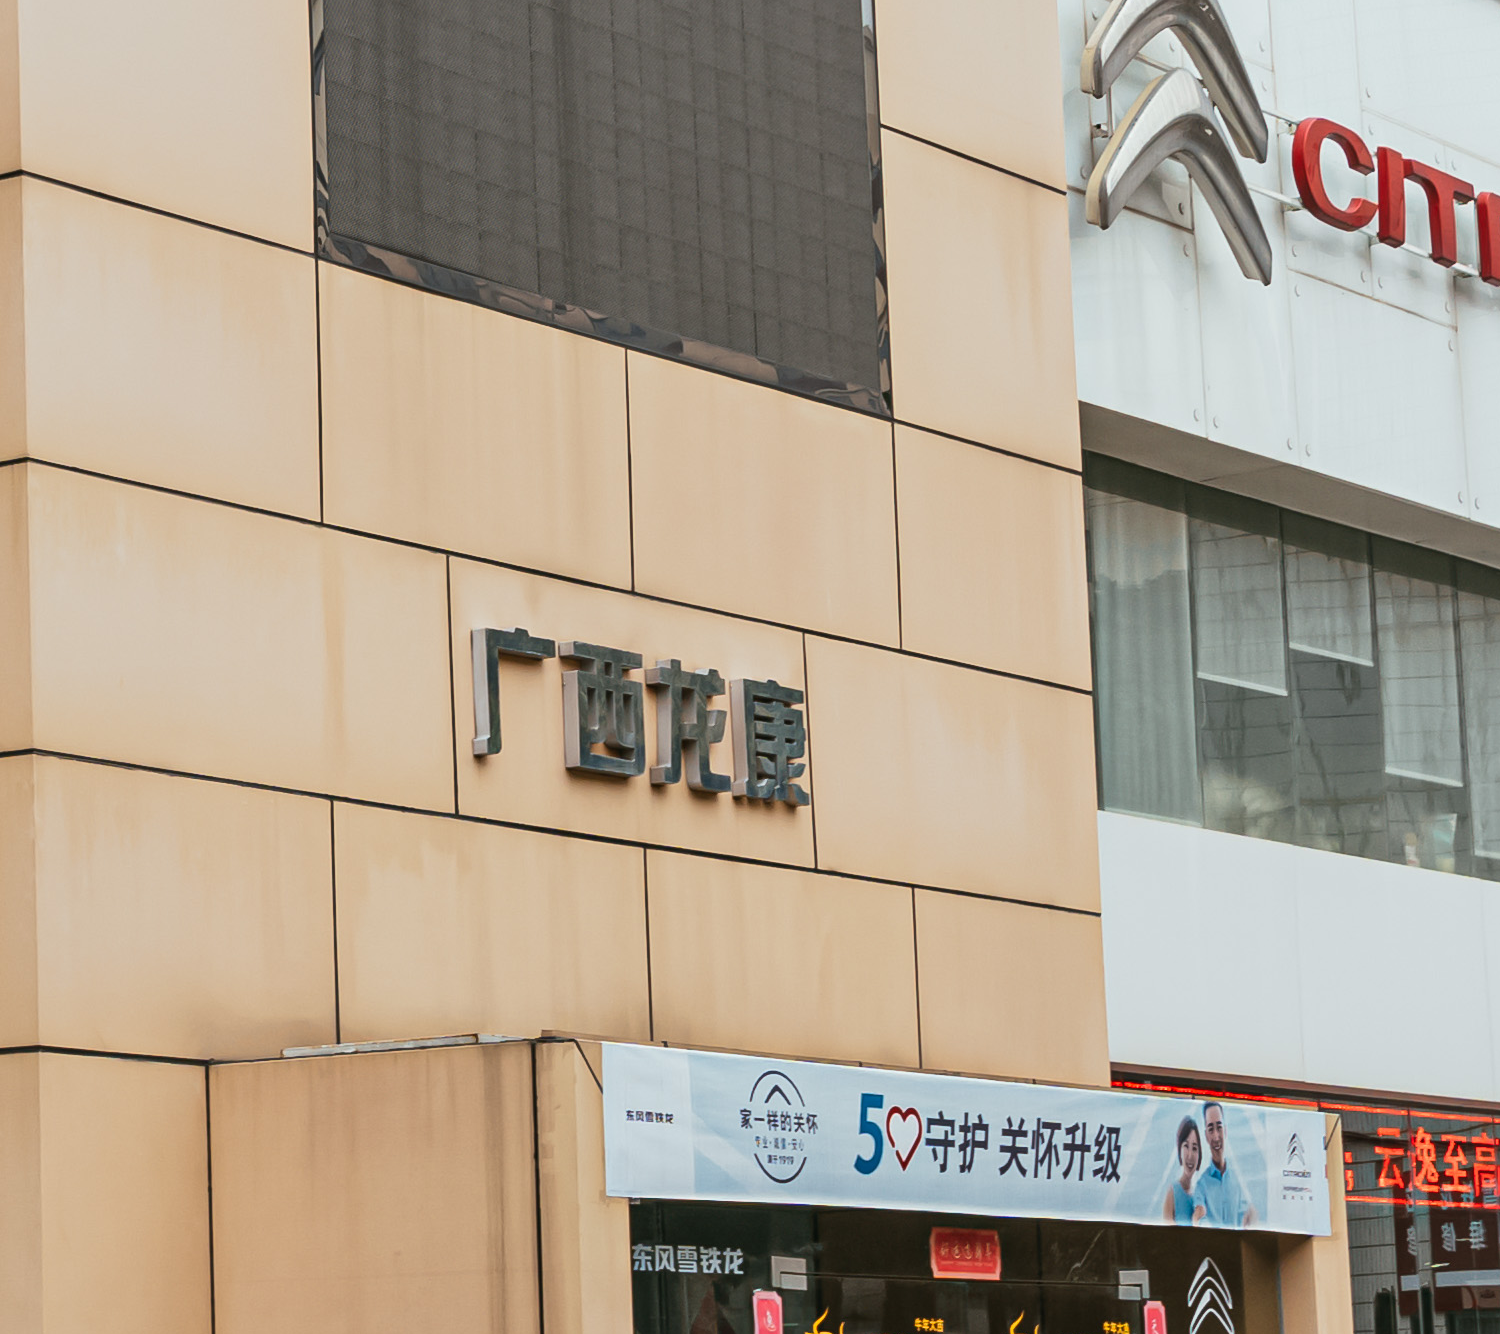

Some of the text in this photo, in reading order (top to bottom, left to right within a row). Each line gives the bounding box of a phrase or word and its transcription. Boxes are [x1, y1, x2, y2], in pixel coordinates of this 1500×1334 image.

[471, 627, 810, 806] 广西龙康
[740, 1108, 819, 1136] 家一样的关怀
[998, 1116, 1121, 1183] 关怀升级
[632, 1243, 744, 1274] 东风雪铁龙
